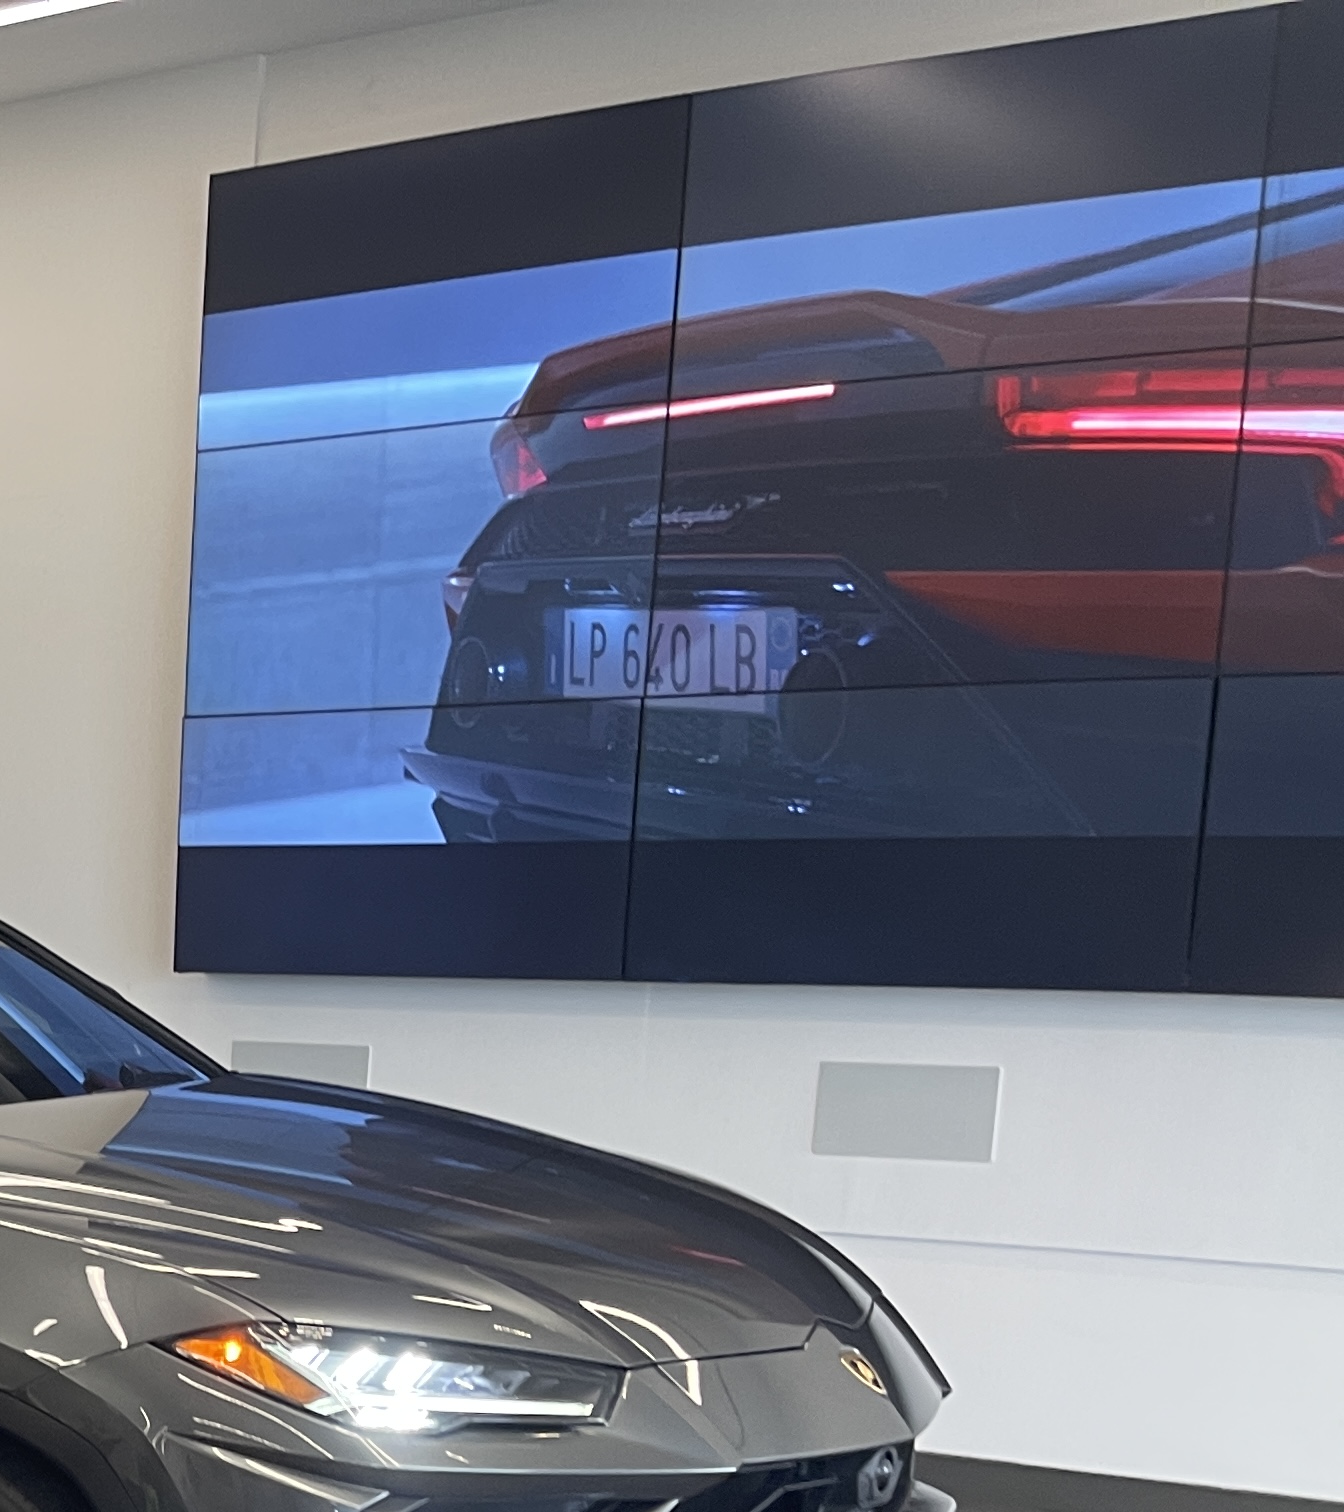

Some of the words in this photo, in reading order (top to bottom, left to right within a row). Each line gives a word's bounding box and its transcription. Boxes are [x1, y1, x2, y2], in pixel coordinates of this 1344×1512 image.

[569, 620, 607, 687] LP
[622, 622, 691, 693] 640
[709, 623, 756, 693] LB
